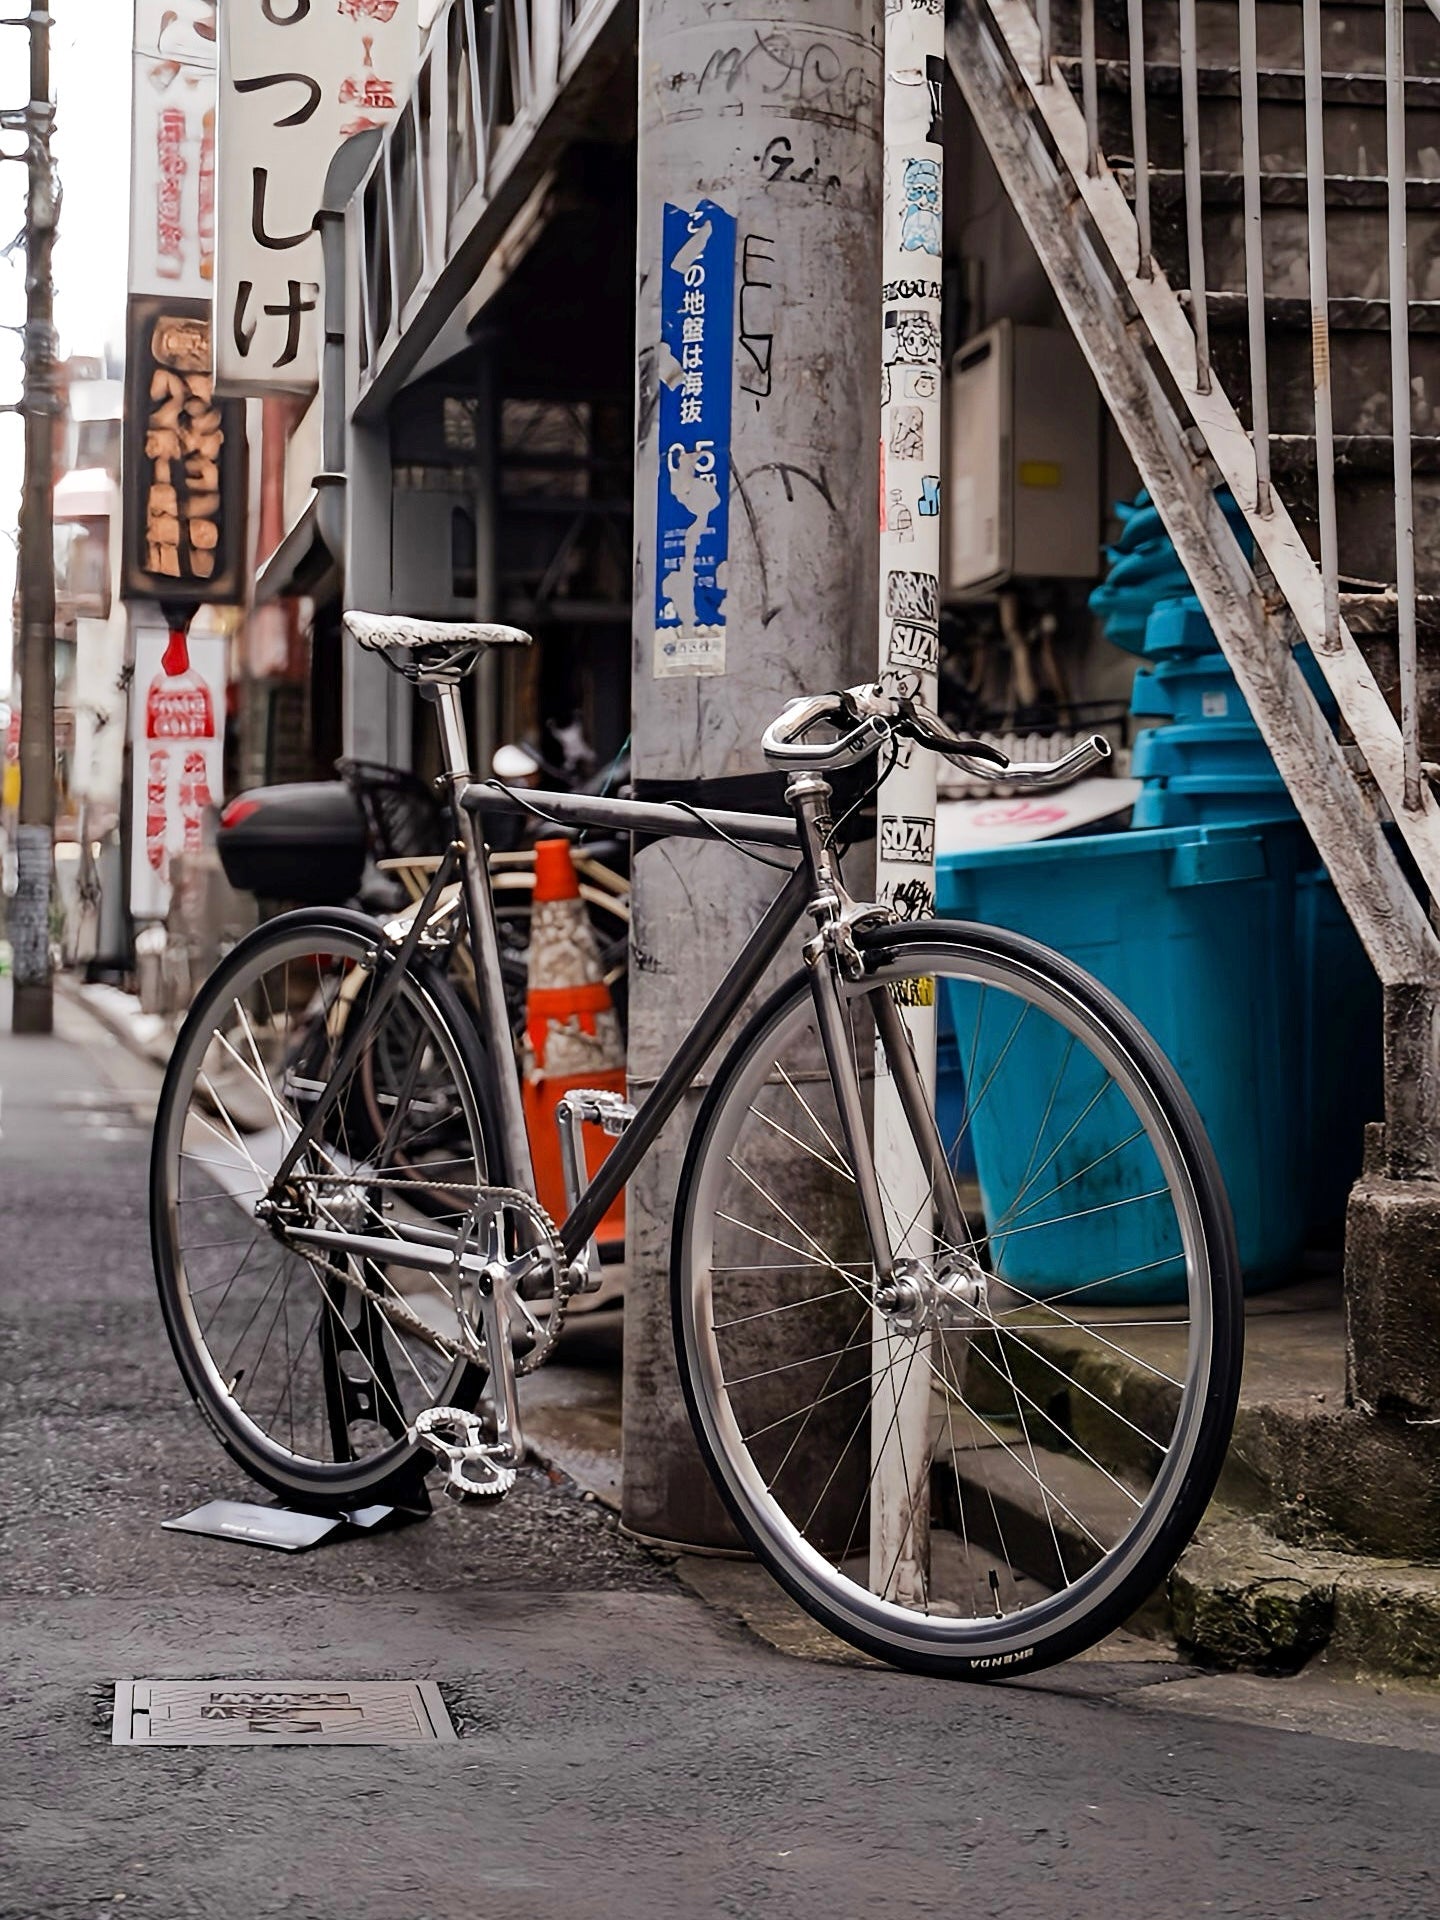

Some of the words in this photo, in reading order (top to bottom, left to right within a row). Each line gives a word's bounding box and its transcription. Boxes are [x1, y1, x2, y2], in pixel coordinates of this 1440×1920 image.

[679, 211, 705, 425] この地盤は海抜
